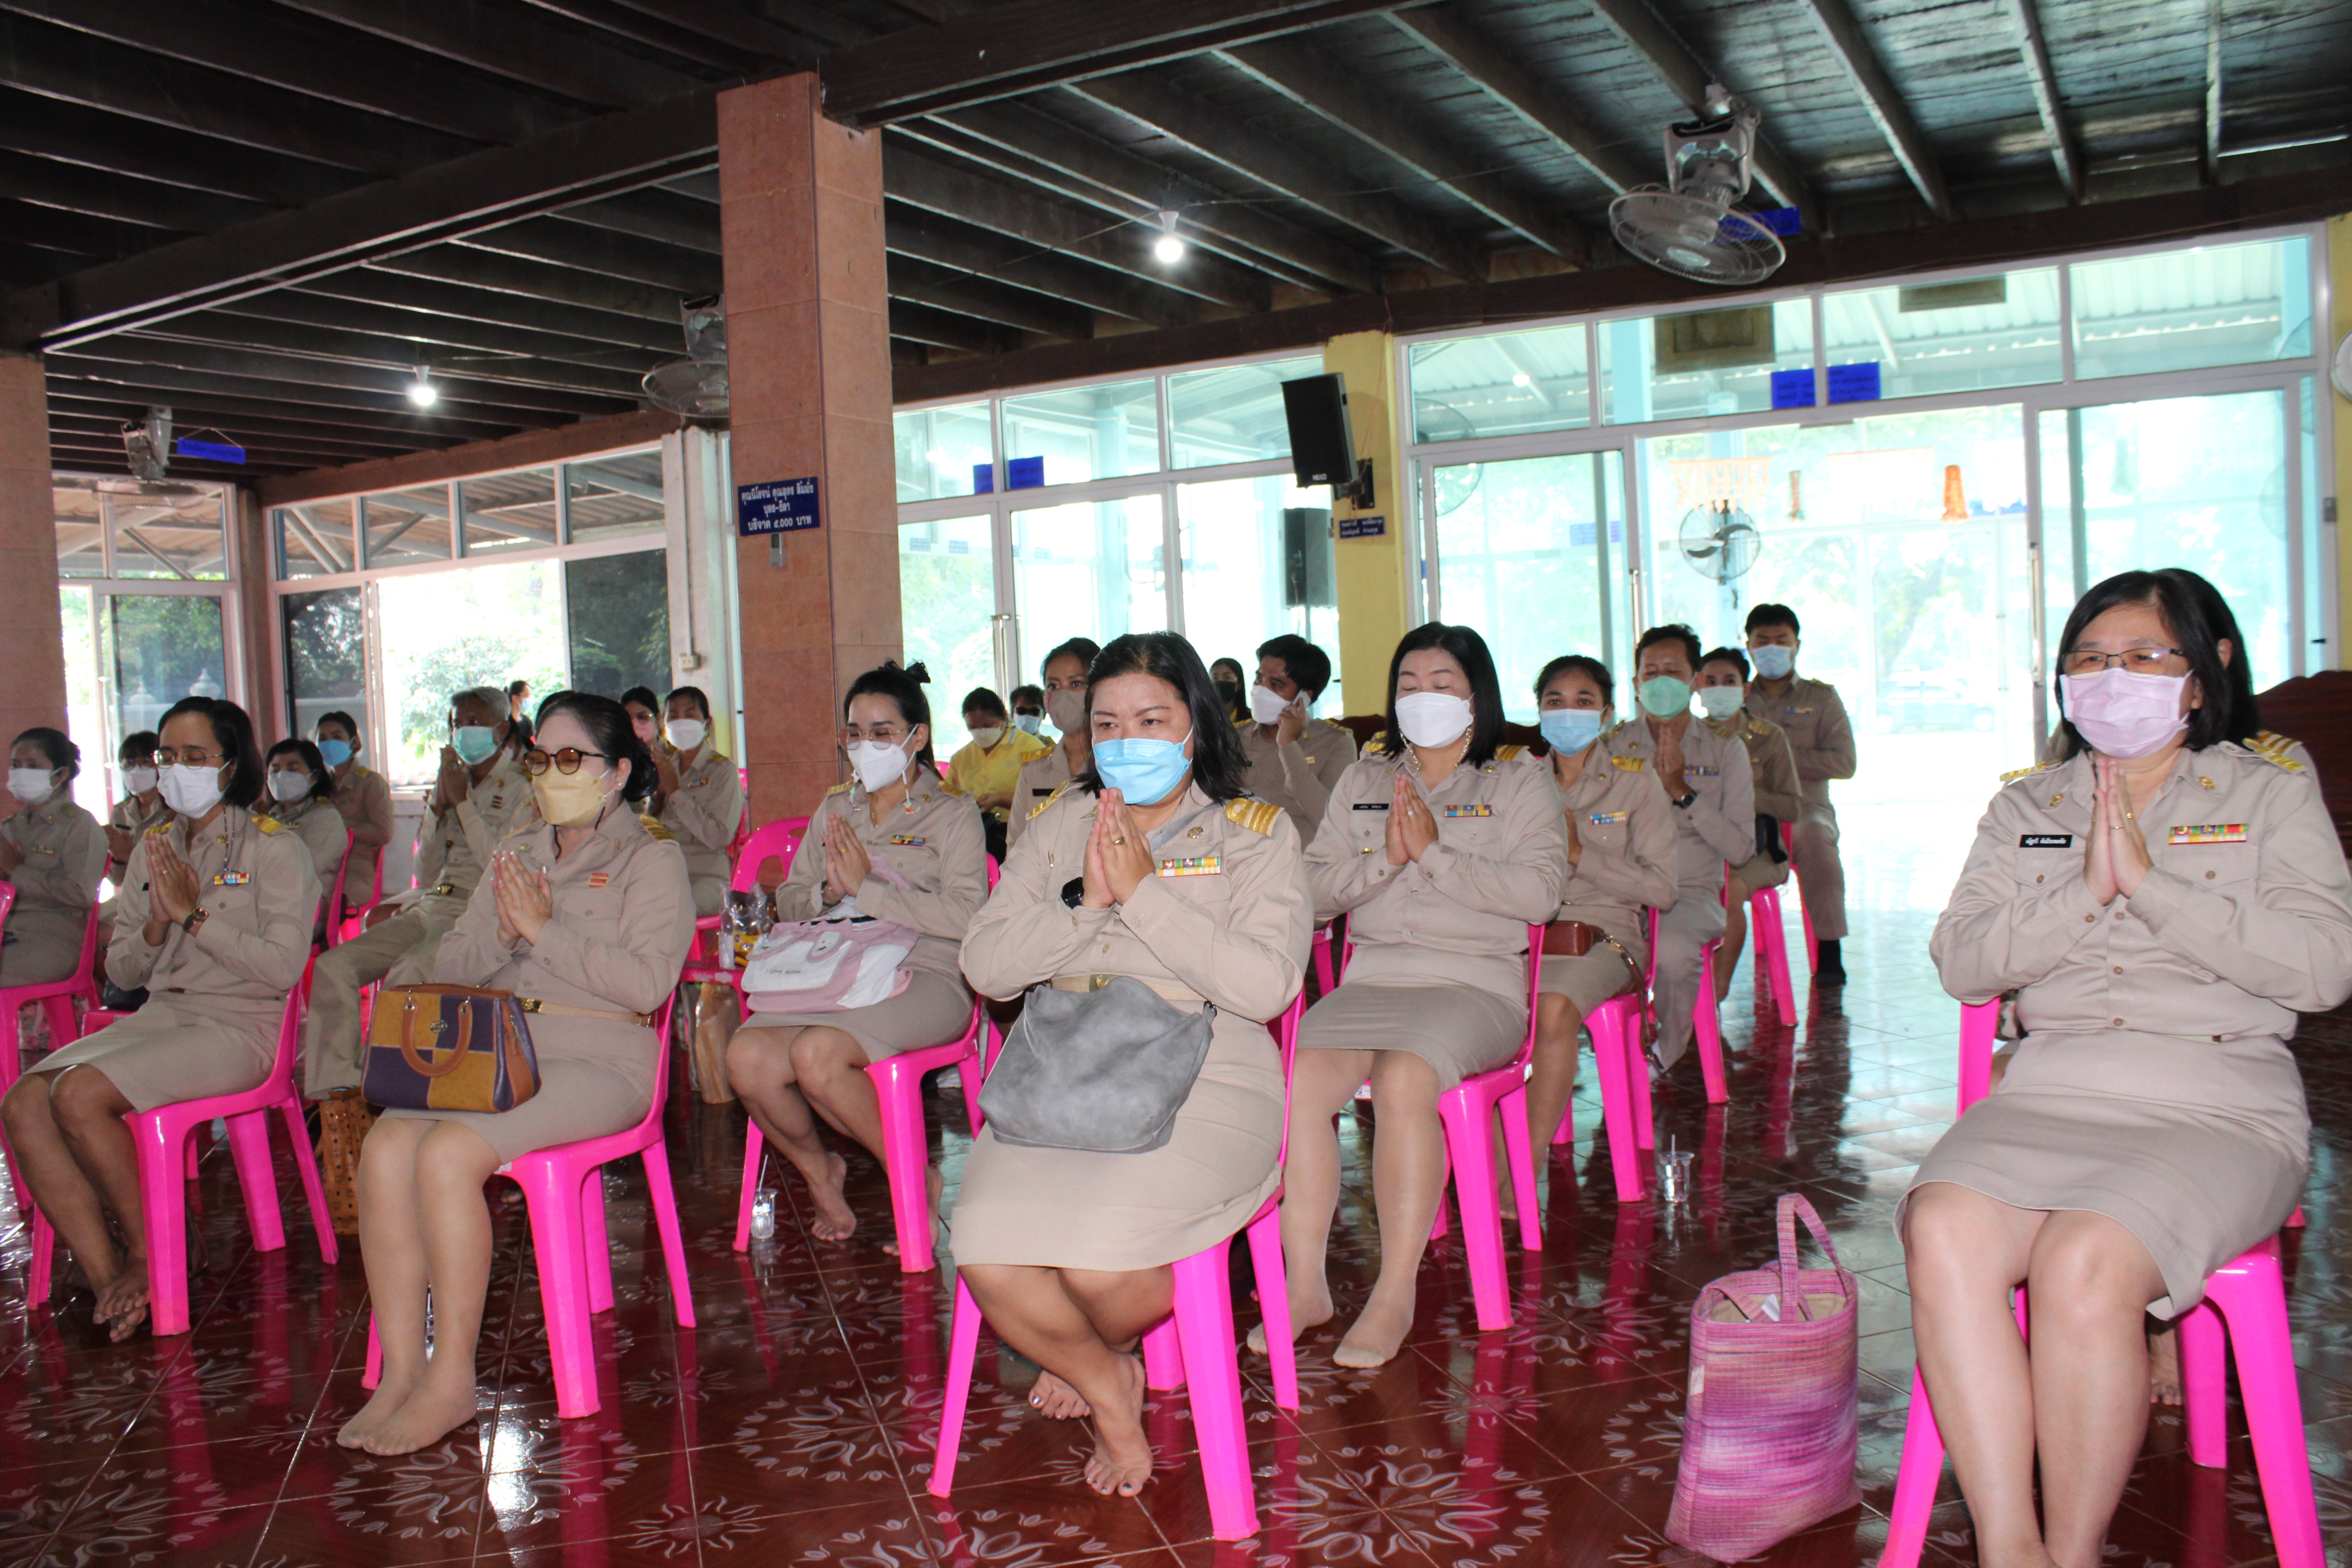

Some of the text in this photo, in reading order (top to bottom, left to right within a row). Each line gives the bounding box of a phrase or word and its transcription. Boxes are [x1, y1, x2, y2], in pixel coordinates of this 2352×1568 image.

[748, 518, 771, 531] บริจาค
[796, 515, 812, 525] บาท
